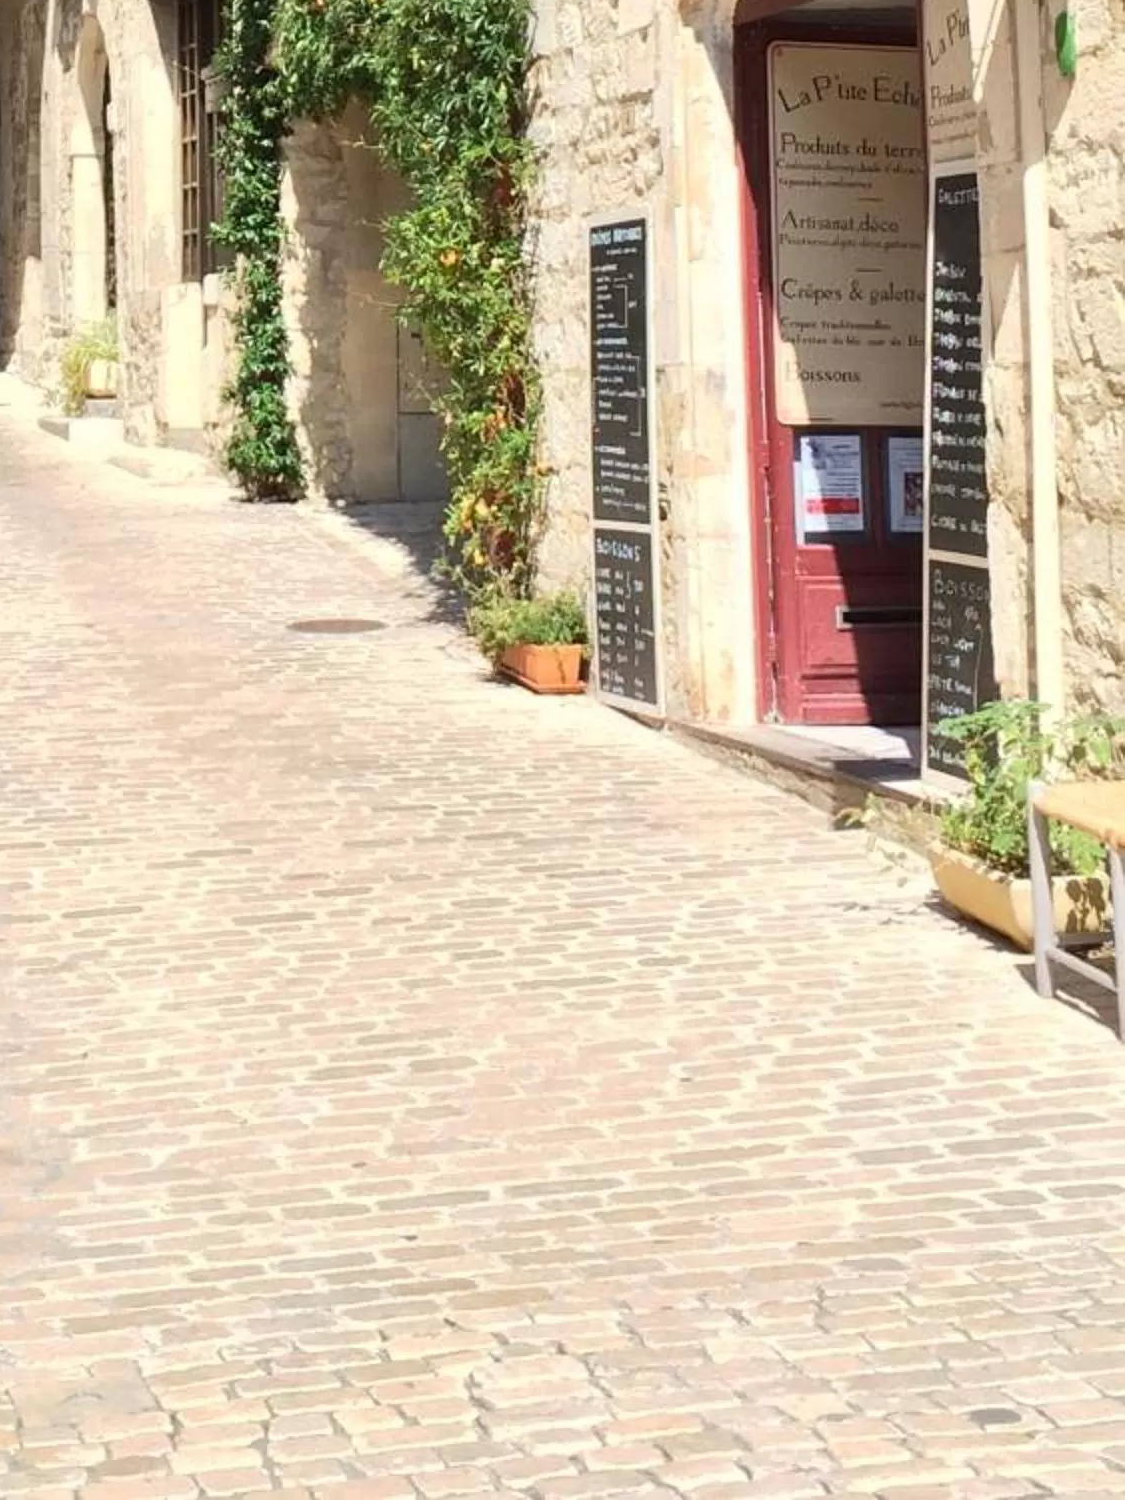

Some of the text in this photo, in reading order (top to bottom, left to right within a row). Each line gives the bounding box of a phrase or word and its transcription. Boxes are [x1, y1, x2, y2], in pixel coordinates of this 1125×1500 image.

[778, 88, 811, 113] La
[781, 132, 850, 156] Produits
[857, 138, 876, 156] du
[781, 278, 842, 305] Crêpes
